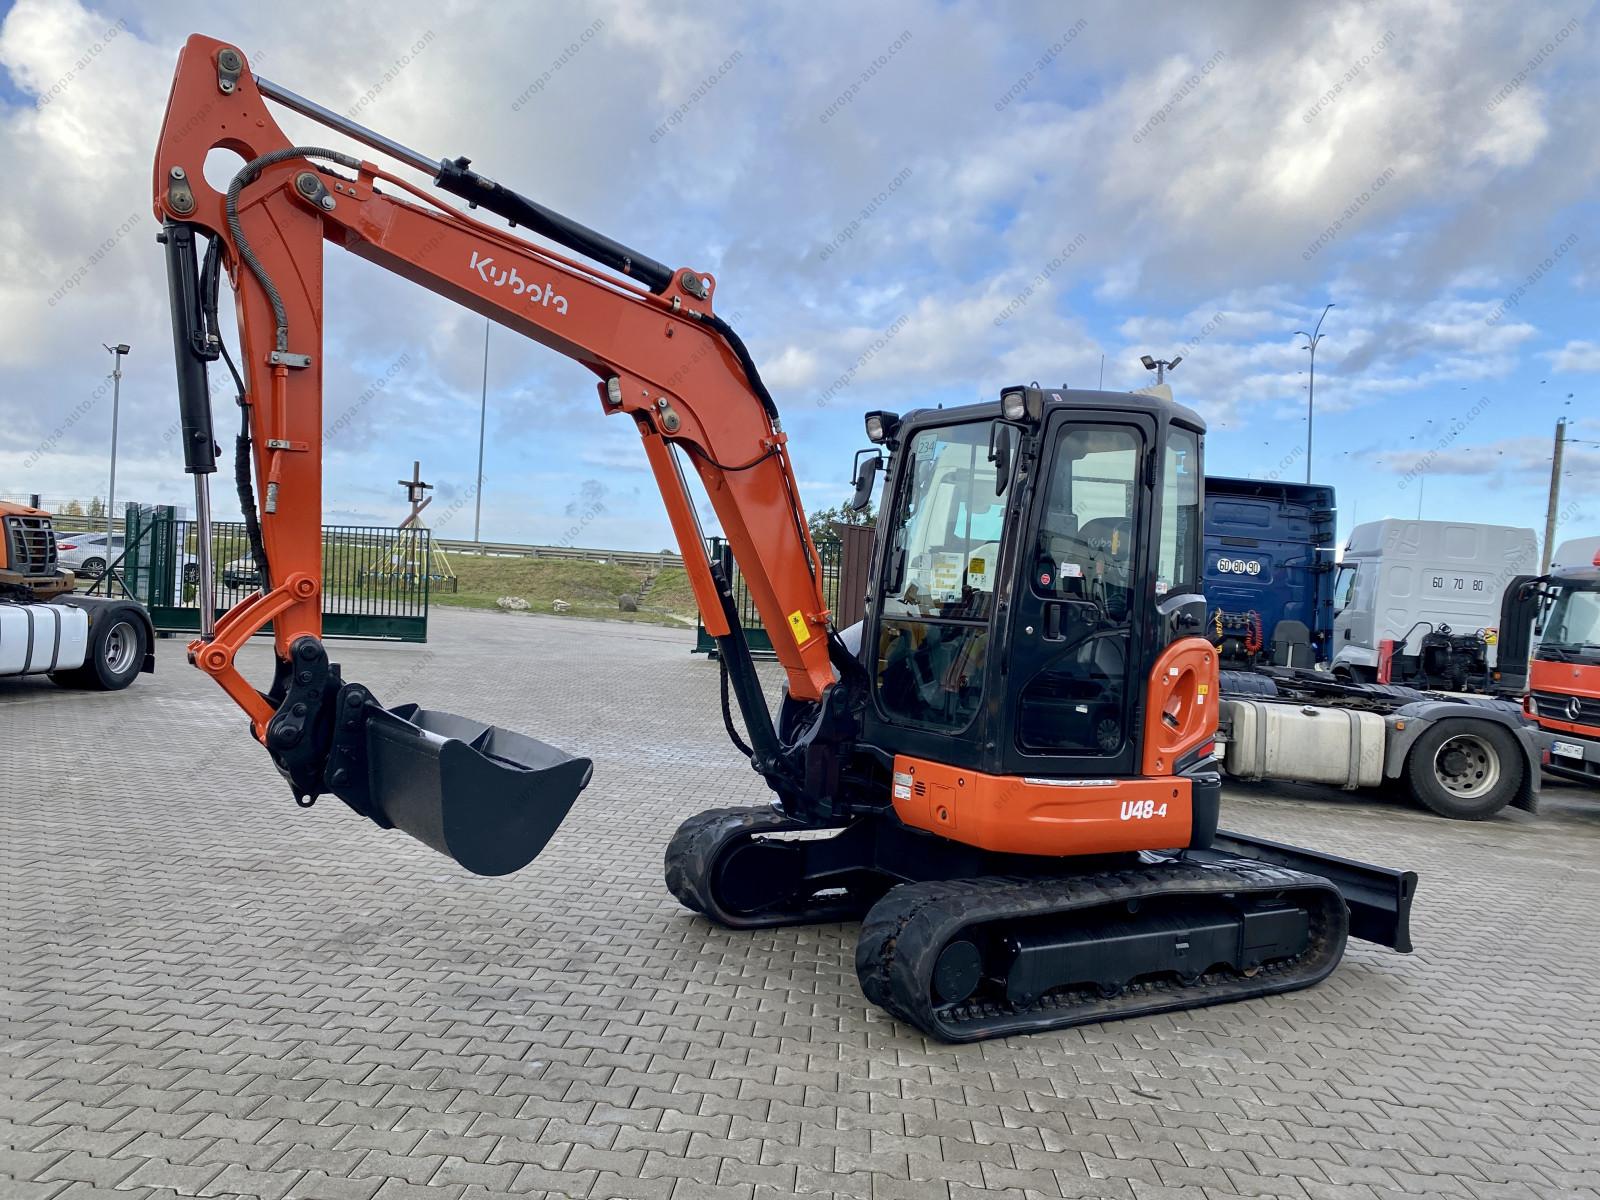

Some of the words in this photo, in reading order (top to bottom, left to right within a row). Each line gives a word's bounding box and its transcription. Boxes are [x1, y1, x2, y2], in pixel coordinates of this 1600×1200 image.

[469, 251, 568, 315] Kubota
[1219, 560, 1230, 571] 60
[1234, 561, 1244, 572] 80
[1248, 562, 1258, 573] 90
[1432, 576, 1443, 588] 60
[1453, 578, 1464, 590] 70
[1472, 579, 1483, 591] 80
[1120, 800, 1168, 821] U48-4
